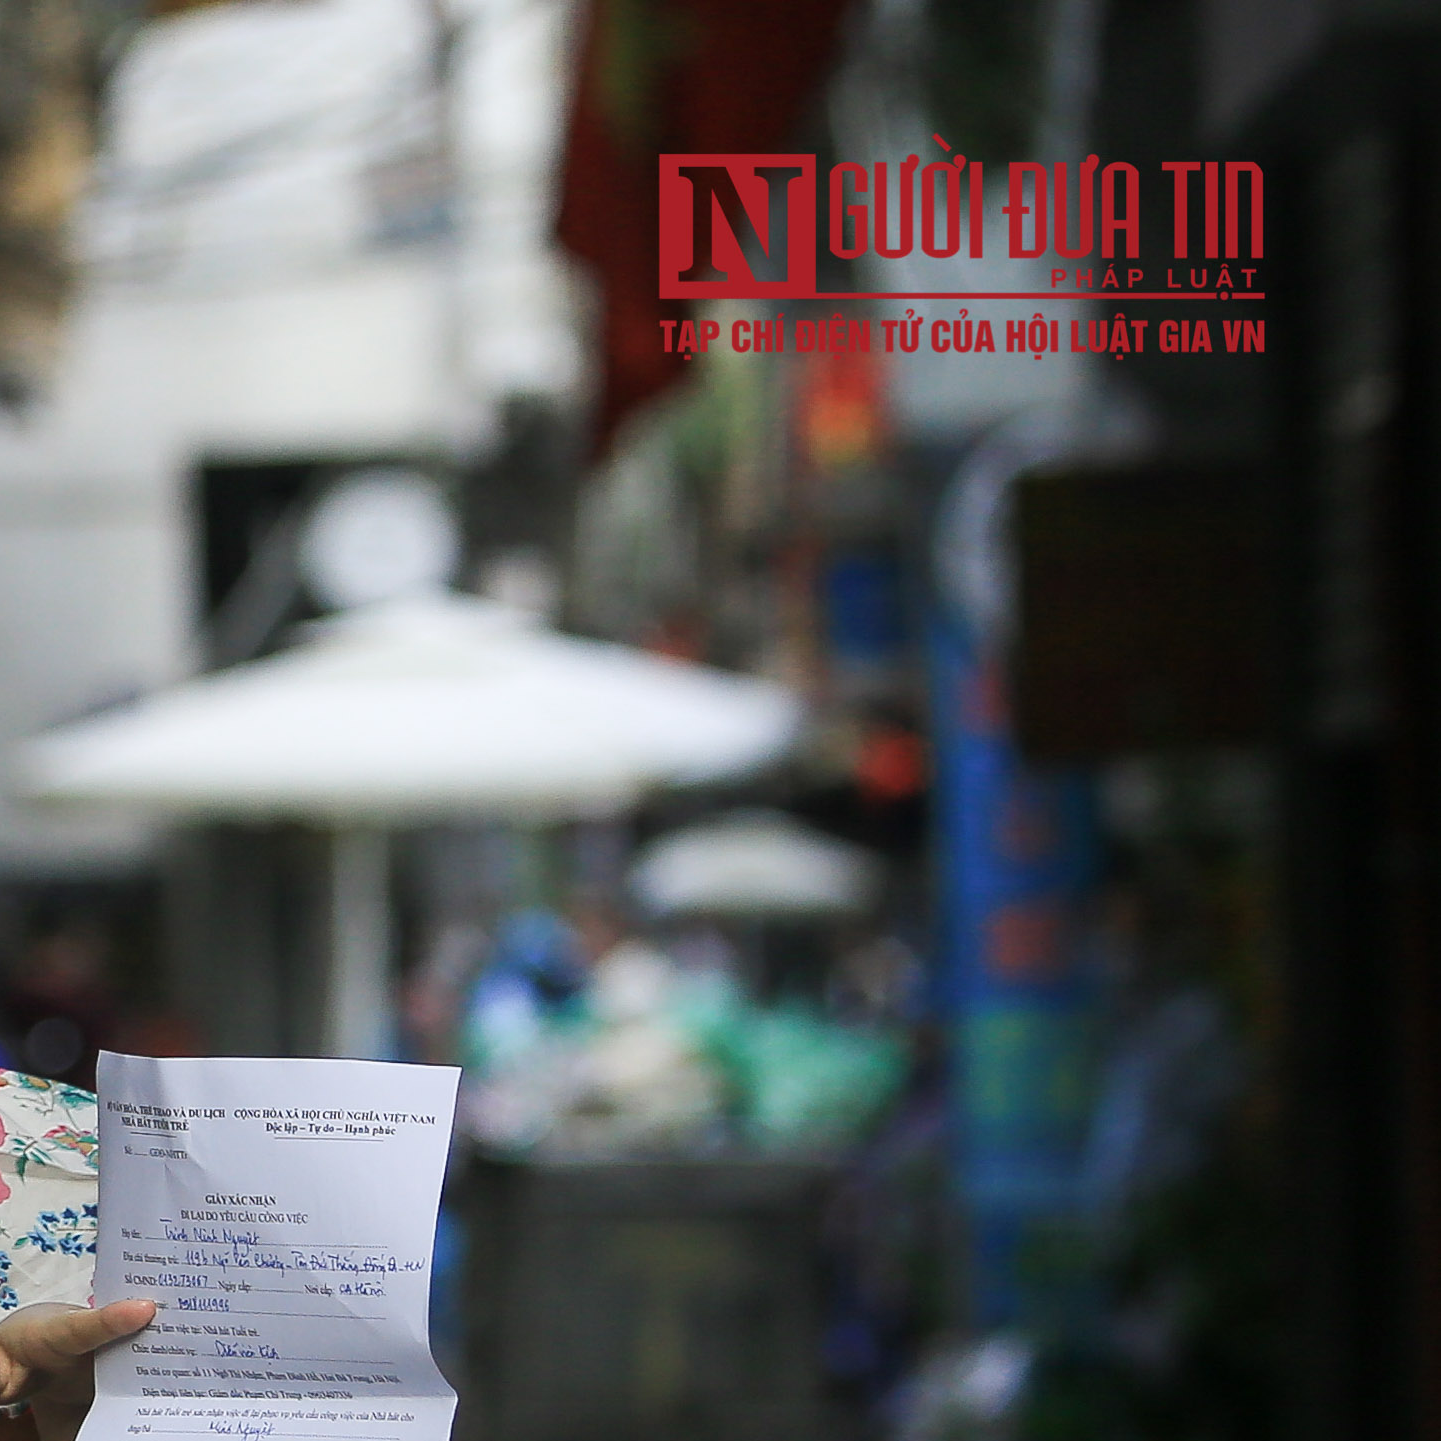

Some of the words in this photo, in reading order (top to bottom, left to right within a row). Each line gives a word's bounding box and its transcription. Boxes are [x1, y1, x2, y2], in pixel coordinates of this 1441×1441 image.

[189, 1109, 202, 1119] DU
[204, 1109, 226, 1120] LỊCH
[234, 1108, 261, 1120] CỘNG
[262, 1108, 283, 1119] HÒA
[285, 1108, 299, 1119] XÃ
[302, 1109, 320, 1121] HỘI
[322, 1108, 343, 1120] CHỦ
[346, 1110, 380, 1122] NGHĨA
[382, 1112, 408, 1124] VIỆT
[410, 1114, 436, 1125] NAM
[266, 1122, 282, 1135] Độc
[284, 1123, 298, 1135] lập
[308, 1124, 320, 1135] Tự
[323, 1124, 334, 1133] do
[344, 1125, 369, 1136] Hạnh
[372, 1126, 396, 1137] phúc
[205, 1193, 228, 1206] GIẤY
[206, 1212, 218, 1222] DO
[286, 1213, 308, 1225] VIỆC
